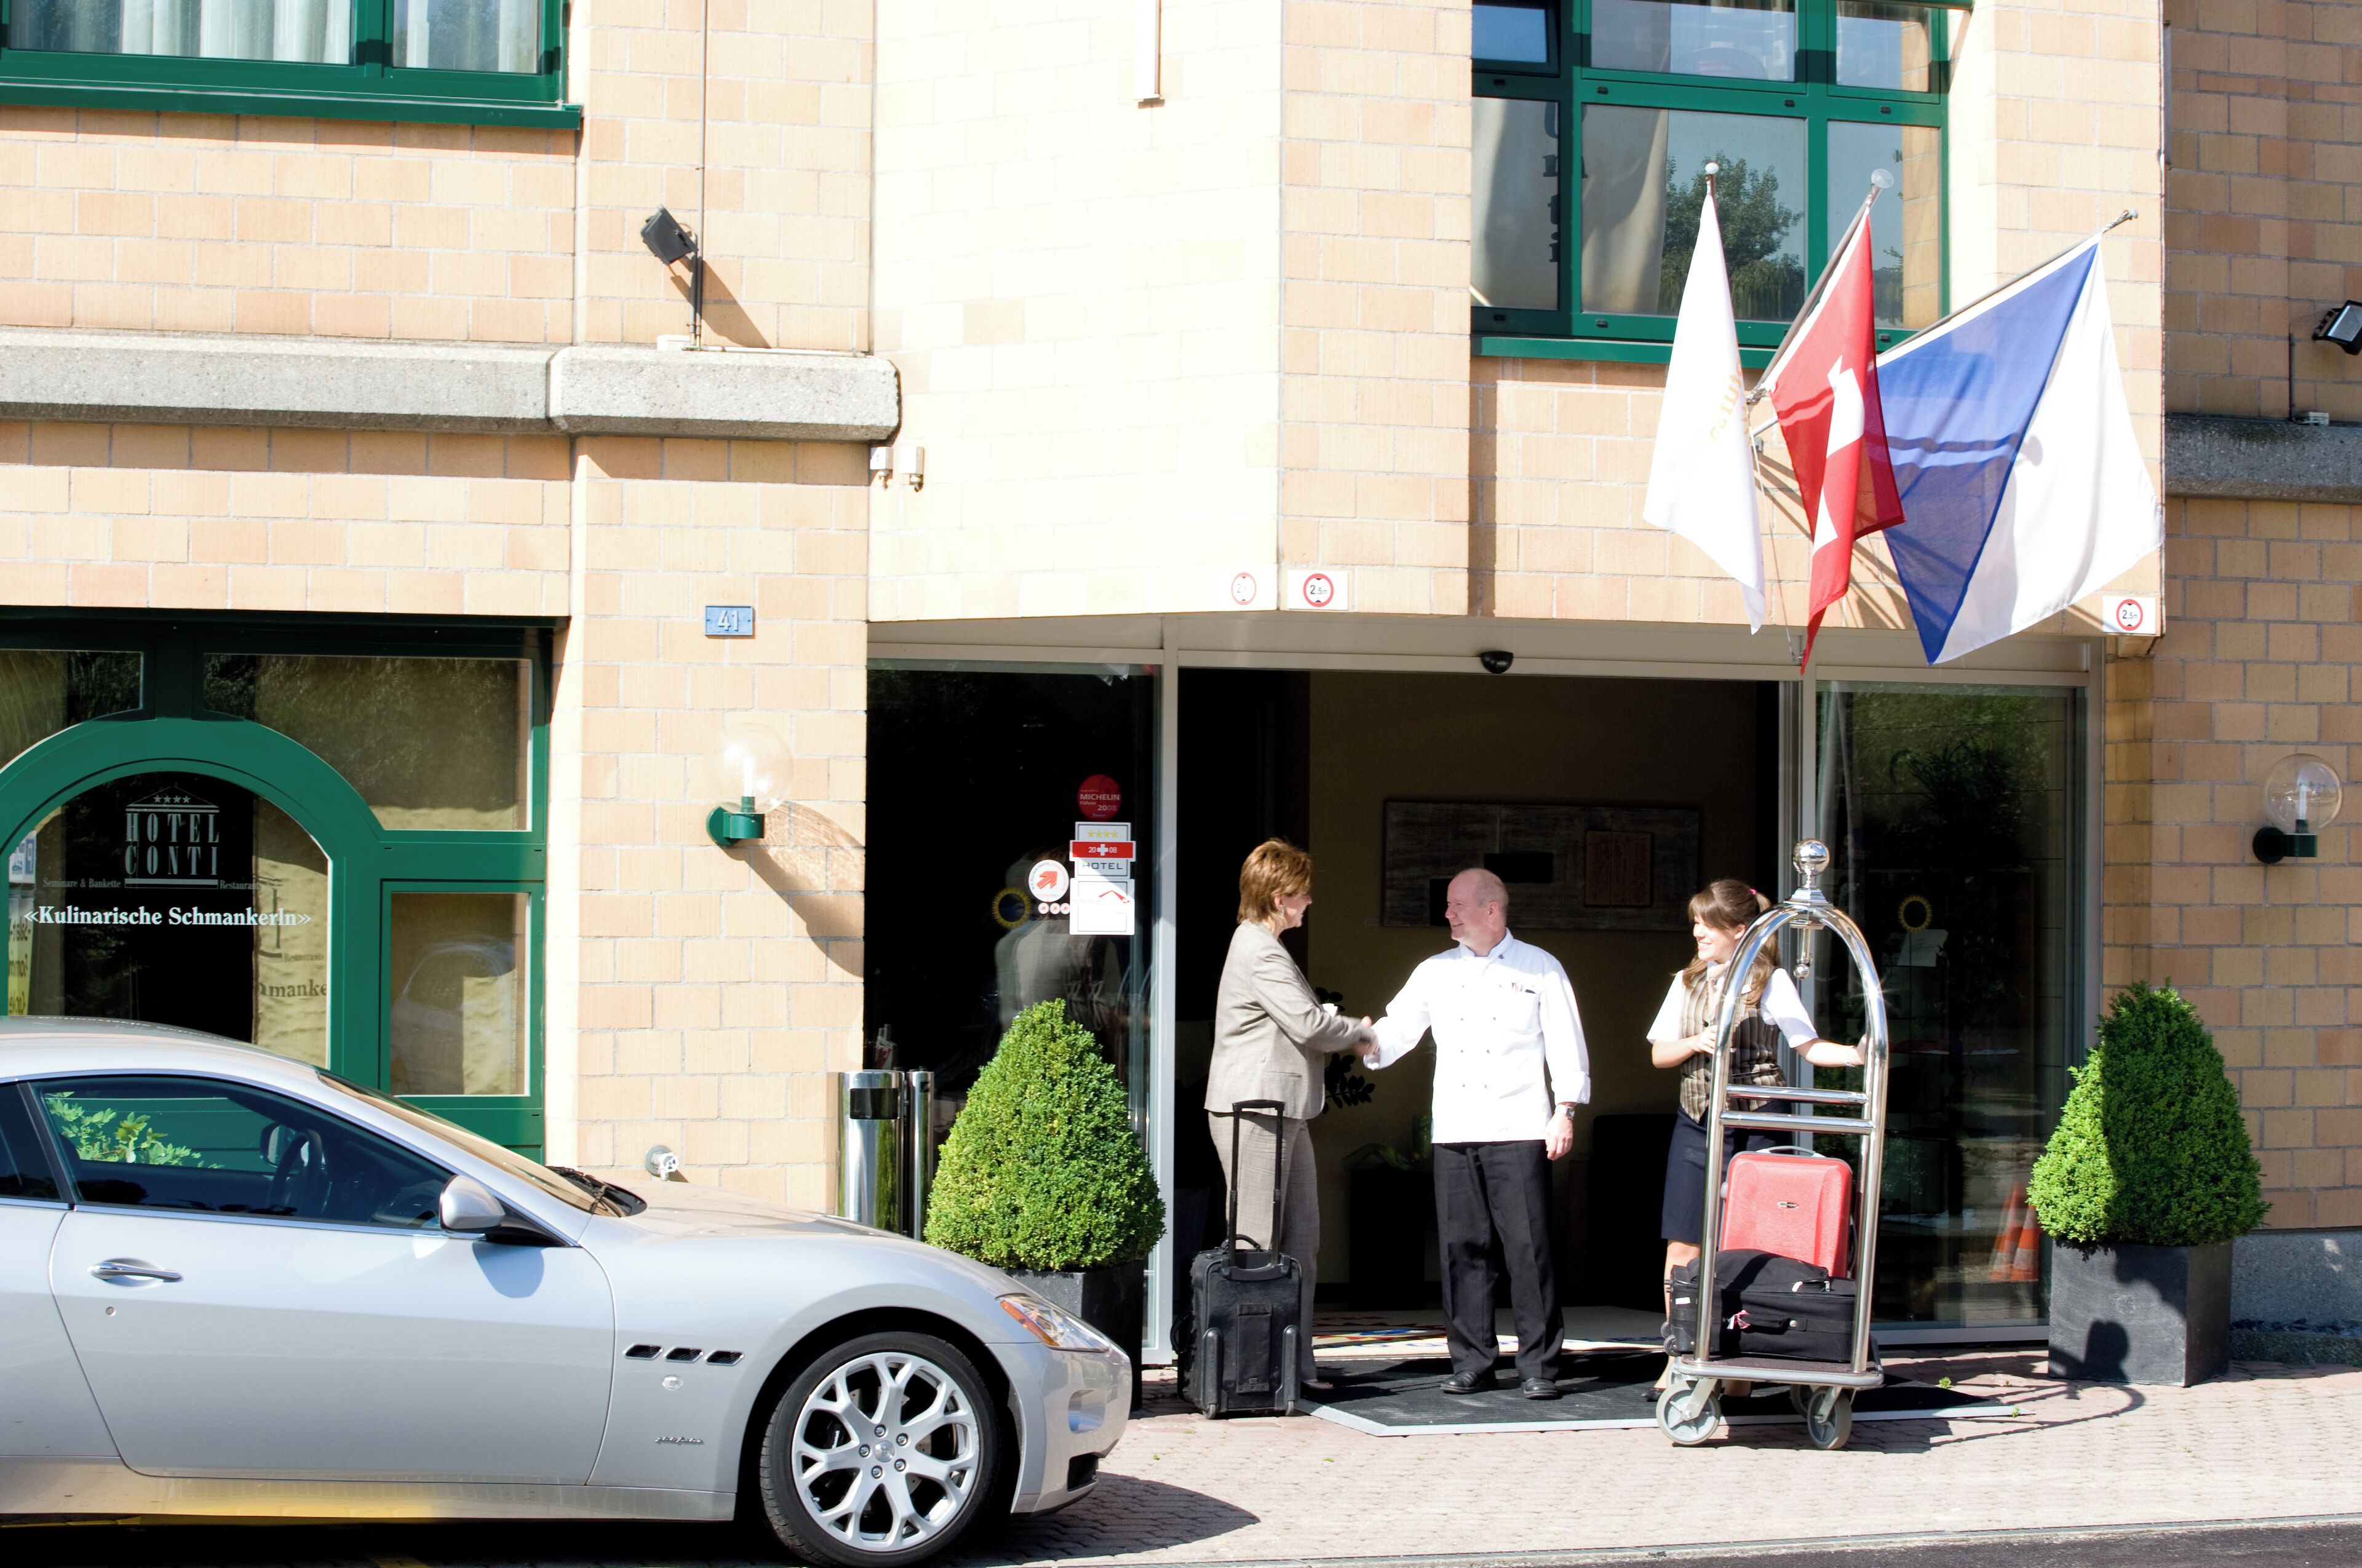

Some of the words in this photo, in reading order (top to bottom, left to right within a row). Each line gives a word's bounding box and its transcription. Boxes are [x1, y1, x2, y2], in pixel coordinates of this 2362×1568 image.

[717, 609, 739, 632] 41
[125, 813, 220, 843] HOTEL
[125, 845, 218, 875] CONTI
[43, 877, 78, 887] Seminare
[80, 878, 86, 888] &
[89, 878, 121, 888] Bankette
[24, 905, 162, 925] «Kulinarische
[169, 907, 312, 926] Schmankerln»
